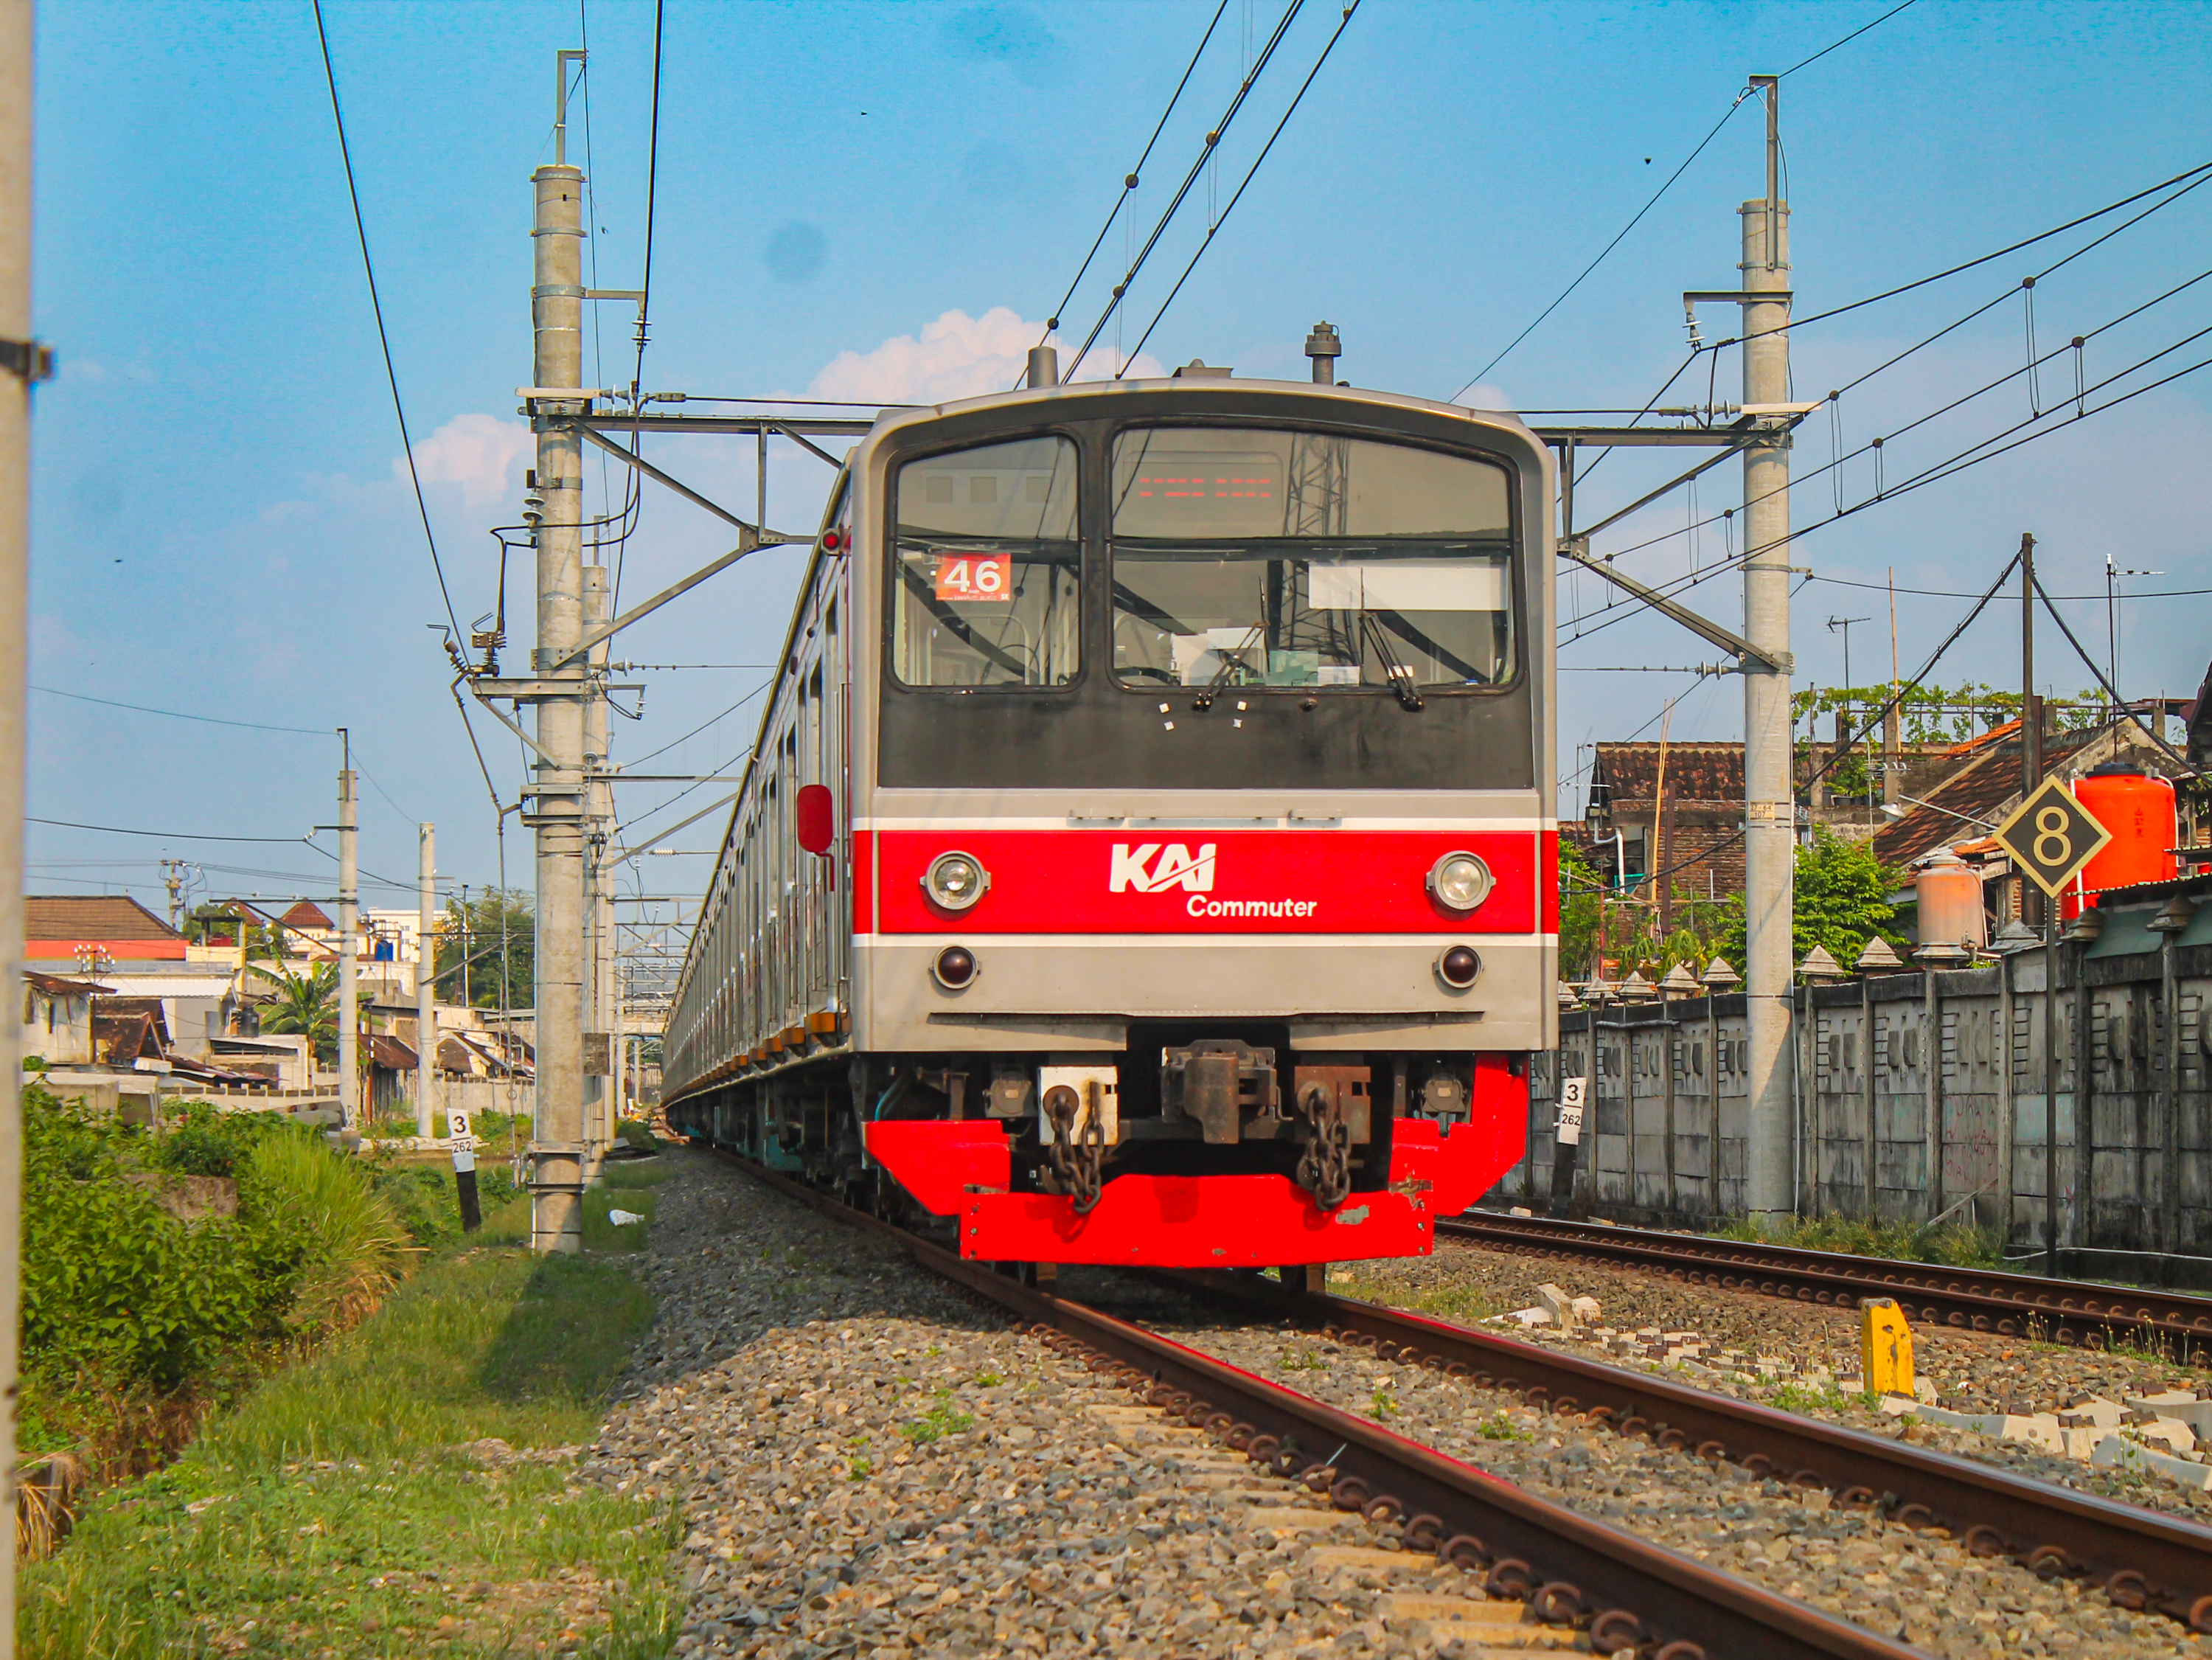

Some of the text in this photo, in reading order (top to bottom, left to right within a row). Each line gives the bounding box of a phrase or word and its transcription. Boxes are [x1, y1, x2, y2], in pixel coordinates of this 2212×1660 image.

[945, 560, 1001, 593] 46
[2033, 806, 2072, 867] 8
[1109, 843, 1217, 892] KAI
[1186, 894, 1318, 917] Commuter
[1566, 1084, 1579, 1102] 3
[453, 1115, 467, 1133] 3
[1562, 1114, 1581, 1126] 262
[453, 1141, 472, 1153] 262
